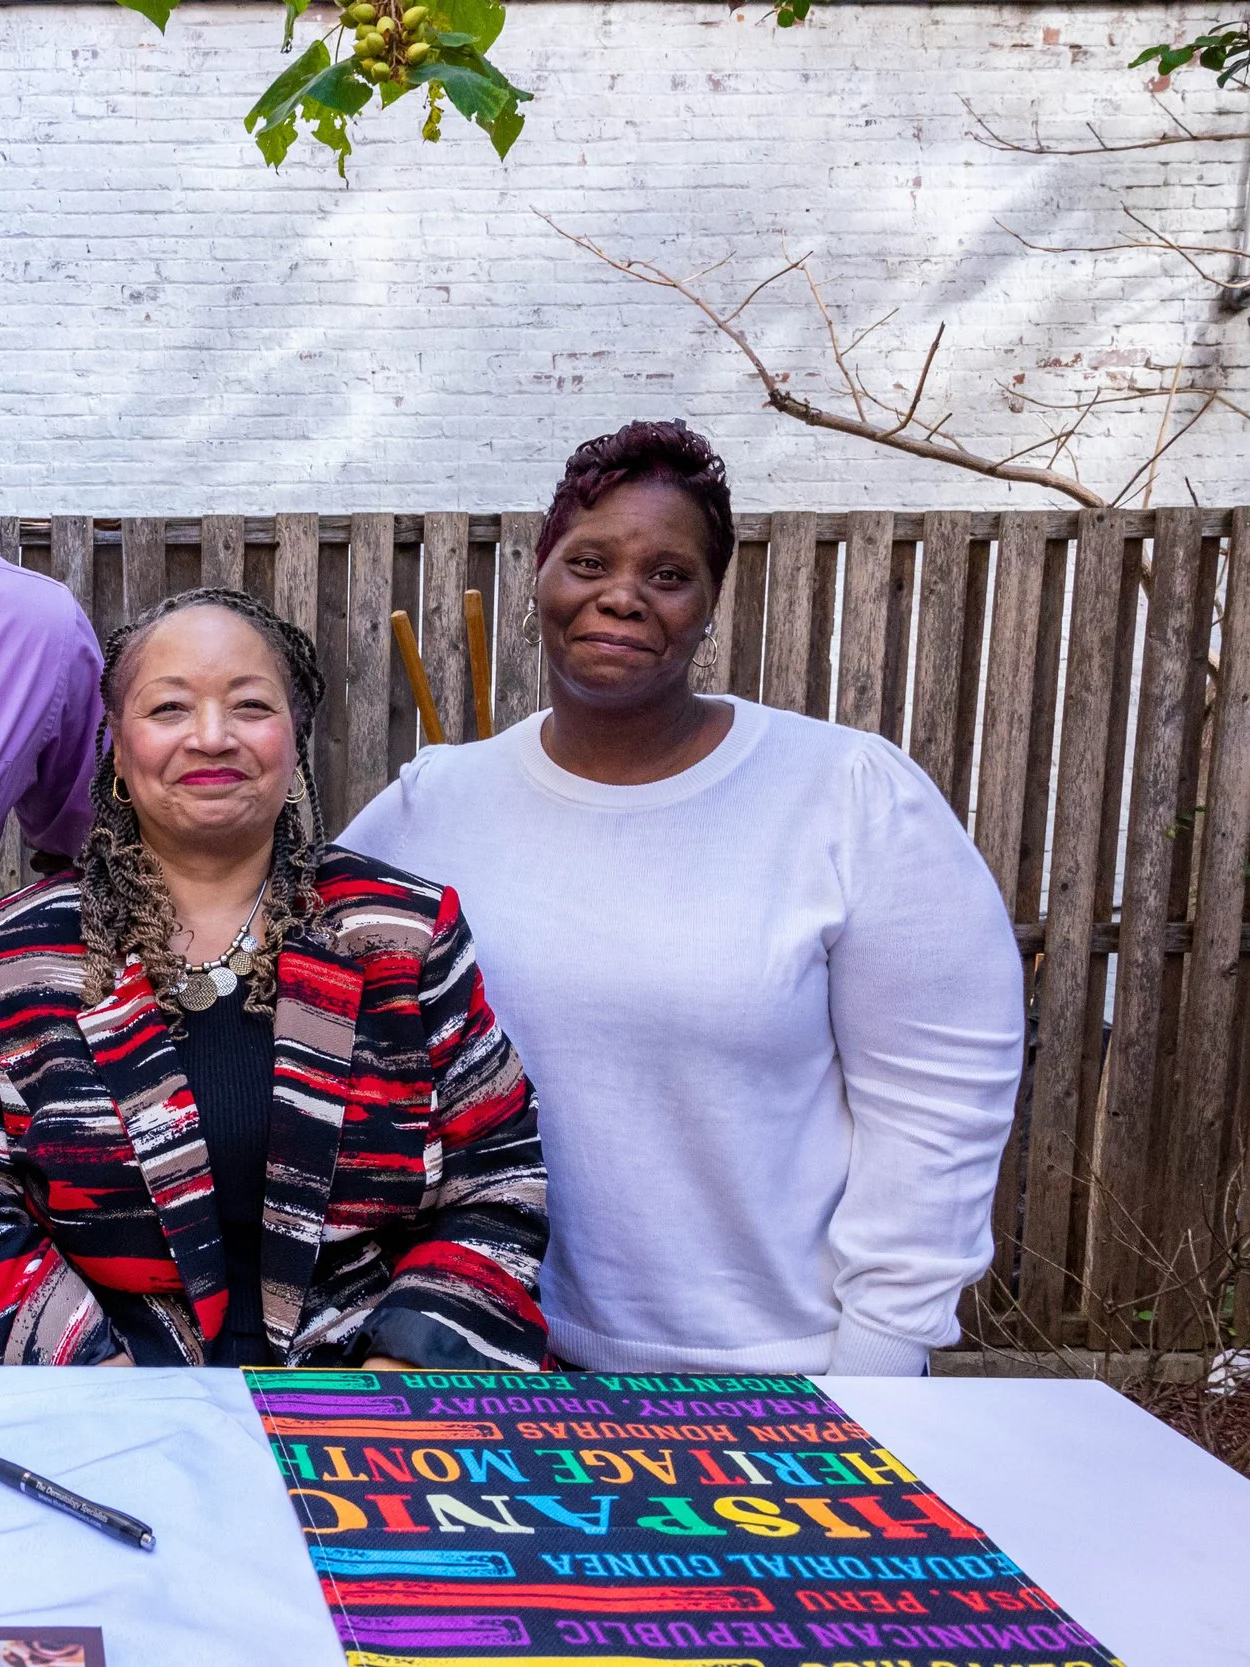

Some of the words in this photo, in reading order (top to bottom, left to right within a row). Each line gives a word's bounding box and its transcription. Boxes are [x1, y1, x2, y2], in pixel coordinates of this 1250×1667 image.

[403, 1373, 575, 1391] ECUADOR
[429, 1397, 614, 1416] URUGUAY
[516, 1421, 739, 1442] HONDURAS
[746, 1419, 872, 1444] SPAIN
[270, 1444, 530, 1483] MONTH
[534, 1447, 919, 1486] HERITAGE
[35, 1481, 47, 1492] The
[46, 1486, 81, 1510] Dermatology
[81, 1503, 108, 1523] Specialists
[288, 1488, 987, 1539] HISPANIC
[538, 1552, 722, 1579] GUINEA
[727, 1551, 1025, 1581] EQUATORIAL
[797, 1587, 929, 1615] PERU
[556, 1619, 803, 1650] REPUBLIC
[806, 1620, 1103, 1650] DOMINICAN
